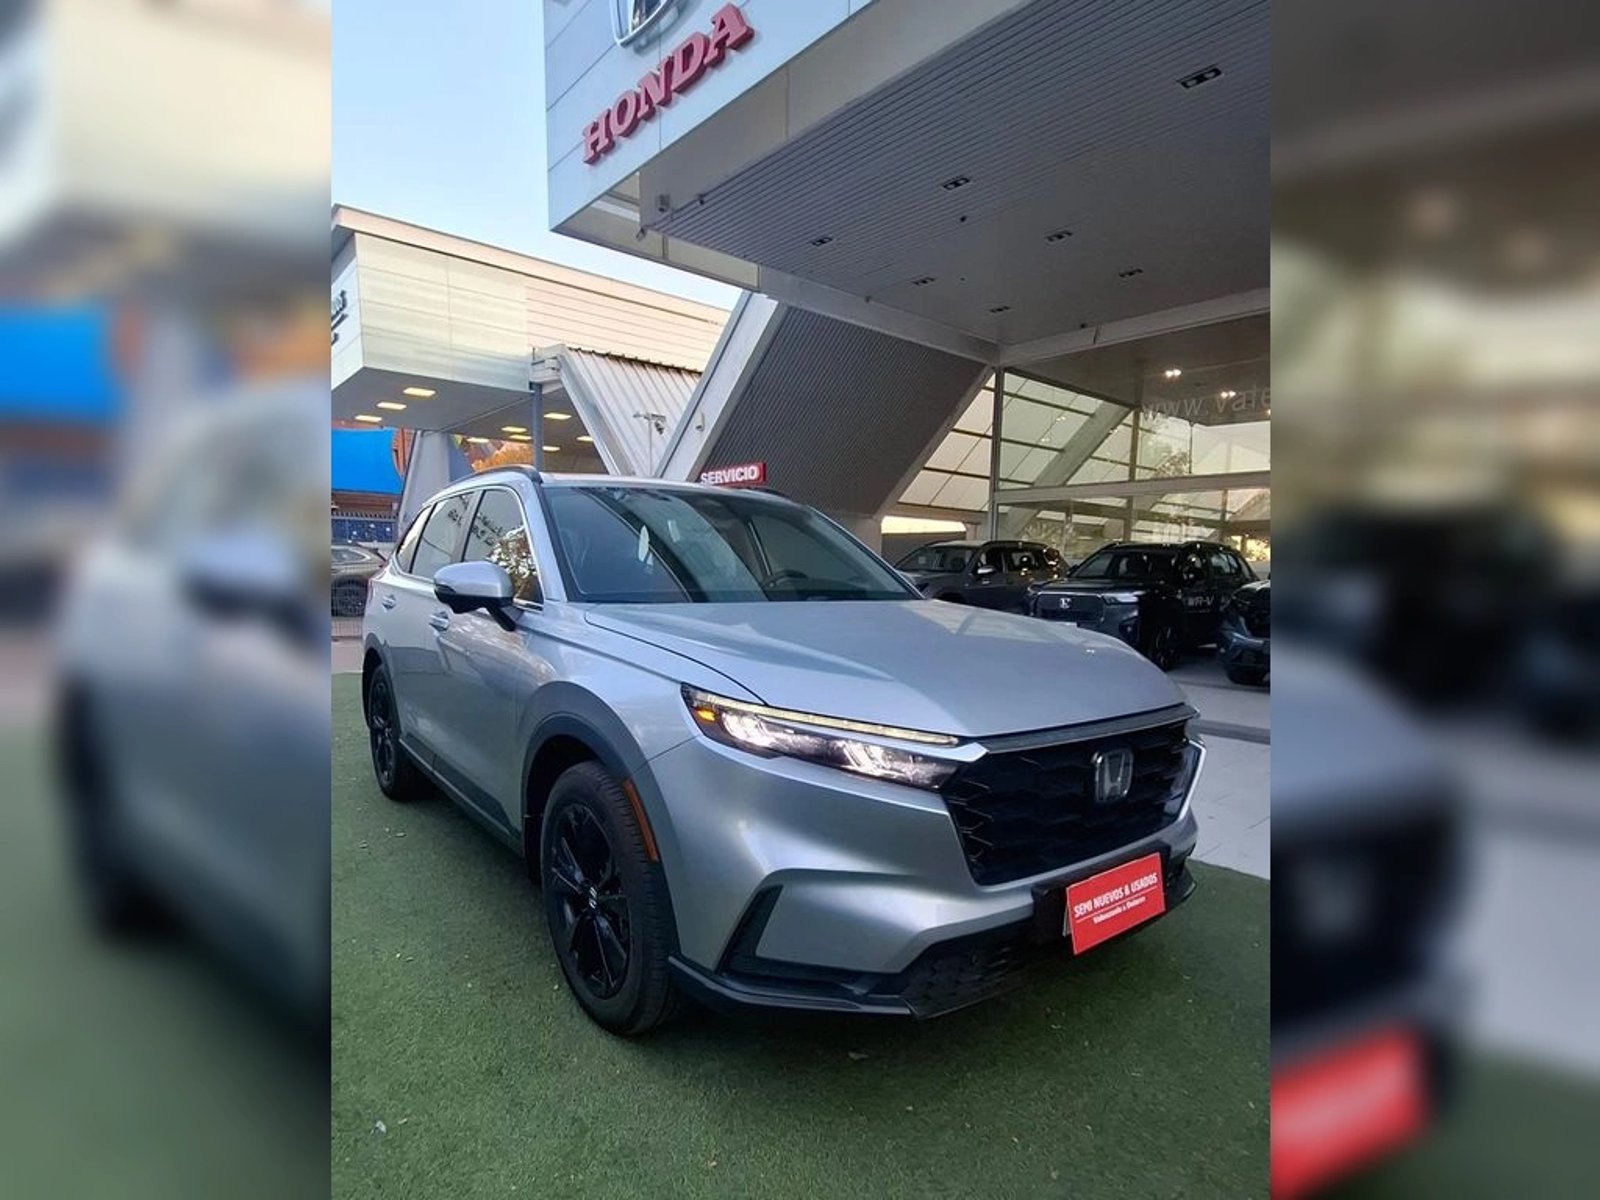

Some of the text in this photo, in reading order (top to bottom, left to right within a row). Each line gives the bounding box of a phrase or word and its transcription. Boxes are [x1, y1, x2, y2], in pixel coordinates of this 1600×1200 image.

[583, 2, 755, 165] HONDA
[701, 465, 760, 485] SERVICIO
[1074, 901, 1093, 918] SEMI
[1093, 885, 1124, 909] NUEVOS
[1131, 872, 1158, 893] USADOS
